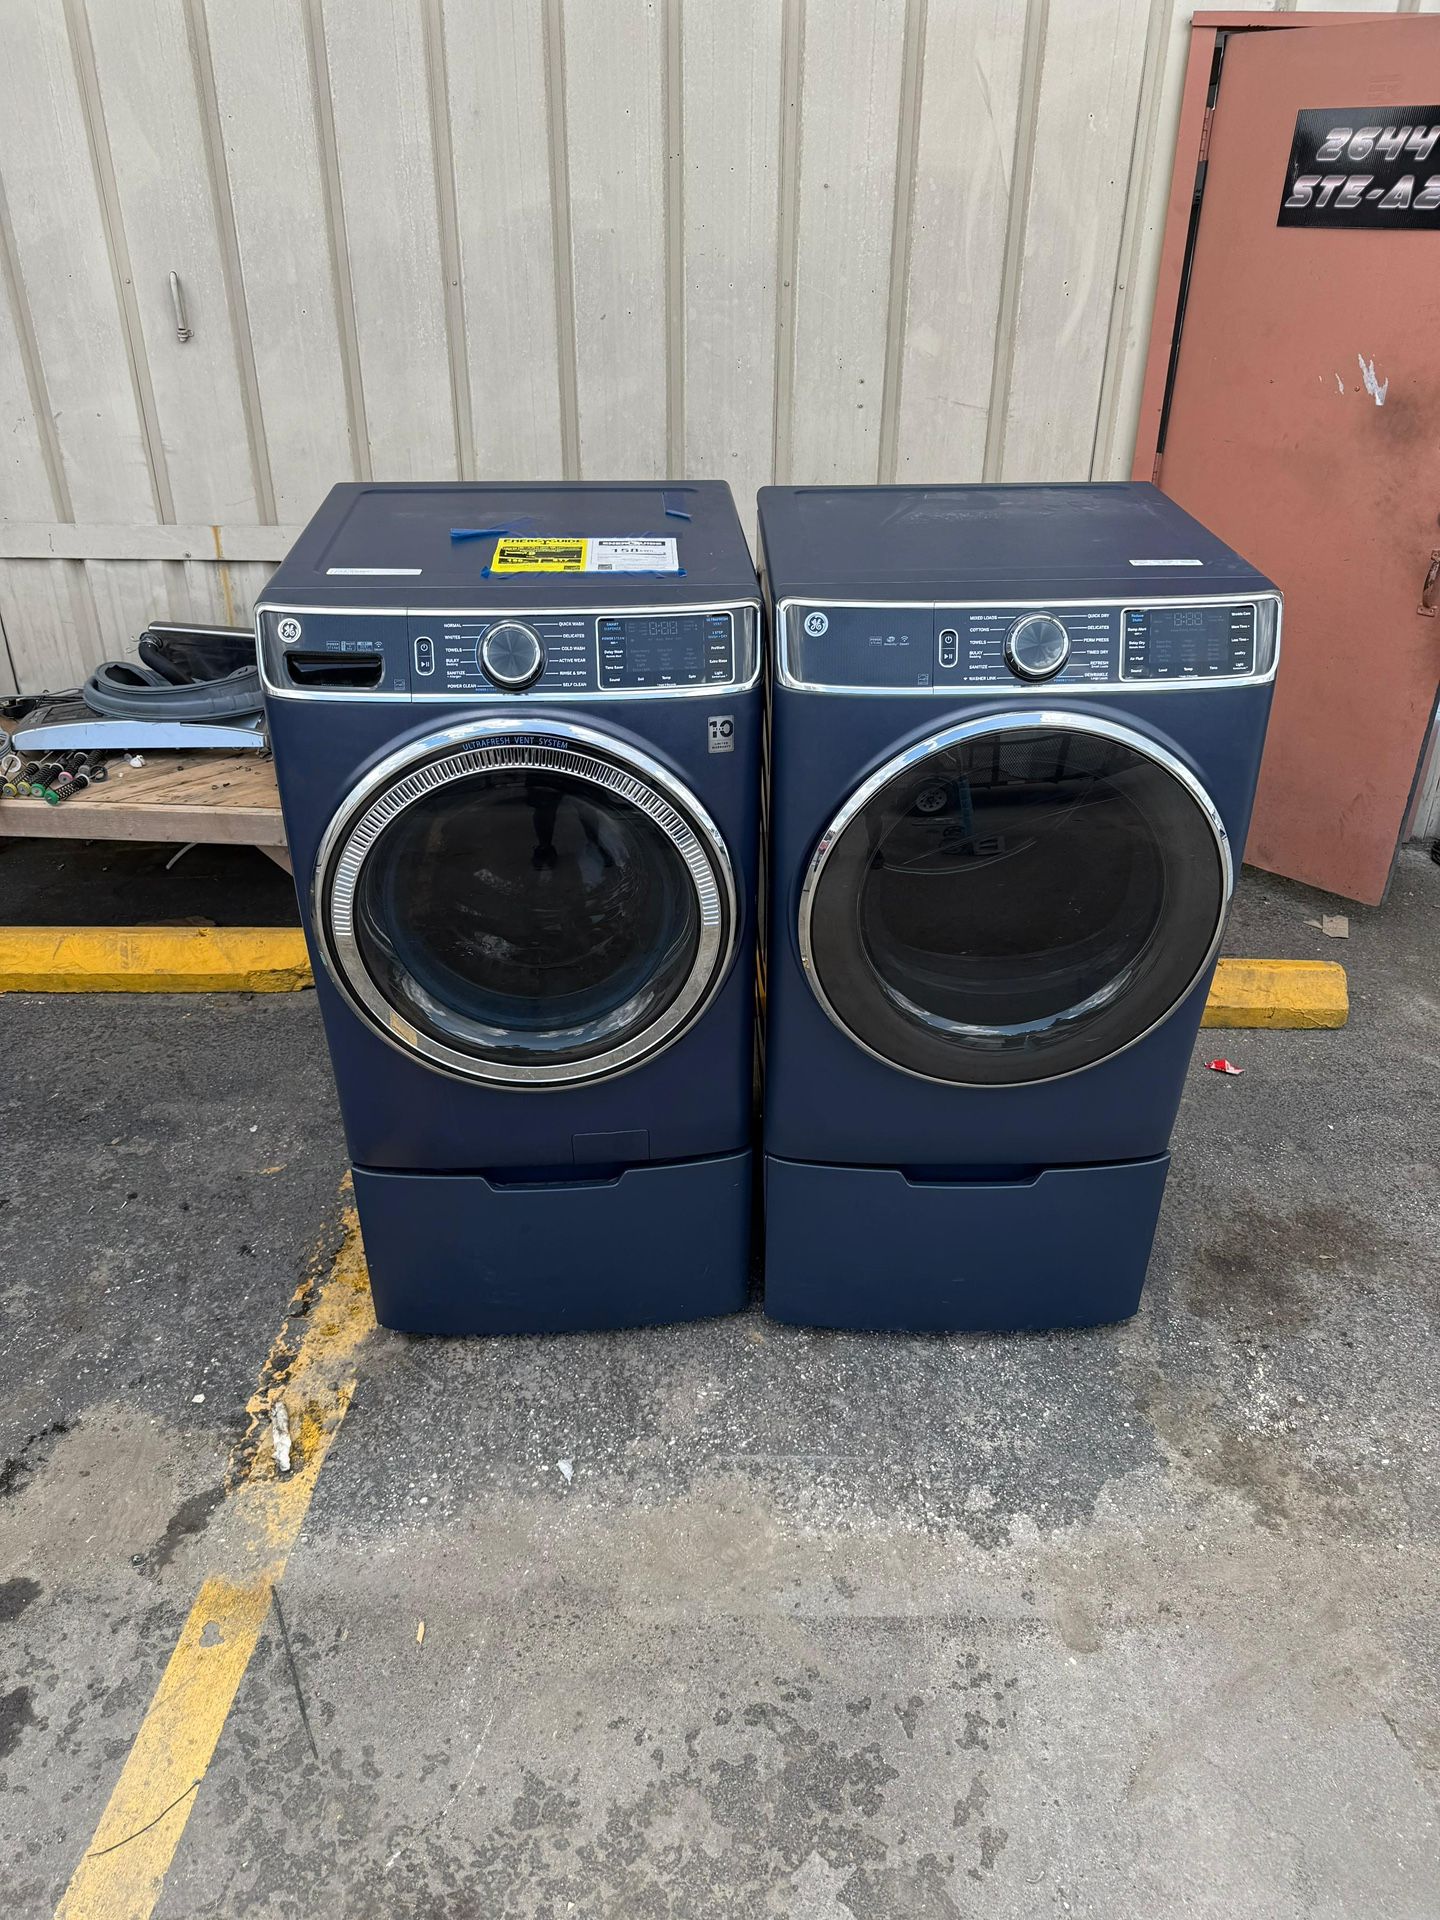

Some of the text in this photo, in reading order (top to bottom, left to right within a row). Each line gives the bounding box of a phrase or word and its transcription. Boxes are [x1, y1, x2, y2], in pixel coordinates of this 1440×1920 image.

[1316, 125, 1440, 161] 2644
[709, 720, 734, 738] 10
[462, 736, 569, 751] ULTRAFRESH VENT SYSTEM
